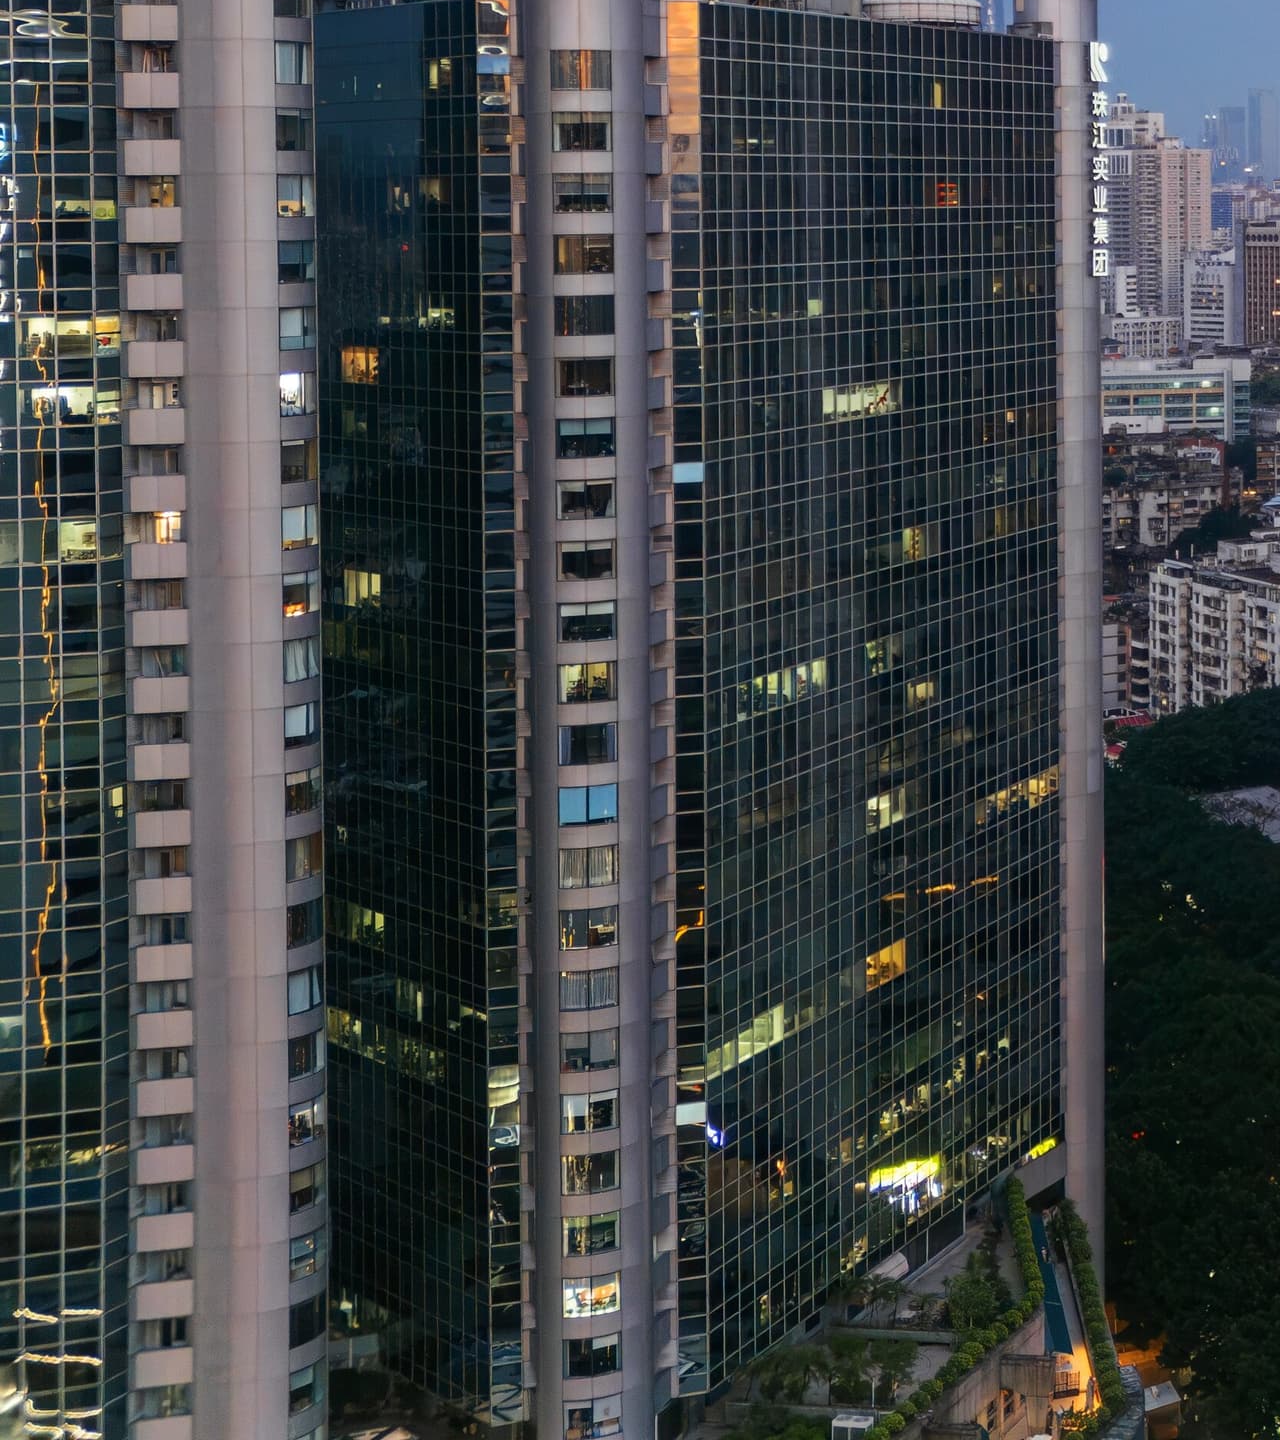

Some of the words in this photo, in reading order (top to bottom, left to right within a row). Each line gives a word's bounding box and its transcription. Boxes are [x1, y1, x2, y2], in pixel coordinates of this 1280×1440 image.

[1092, 91, 1108, 277] 珠江实业集团
